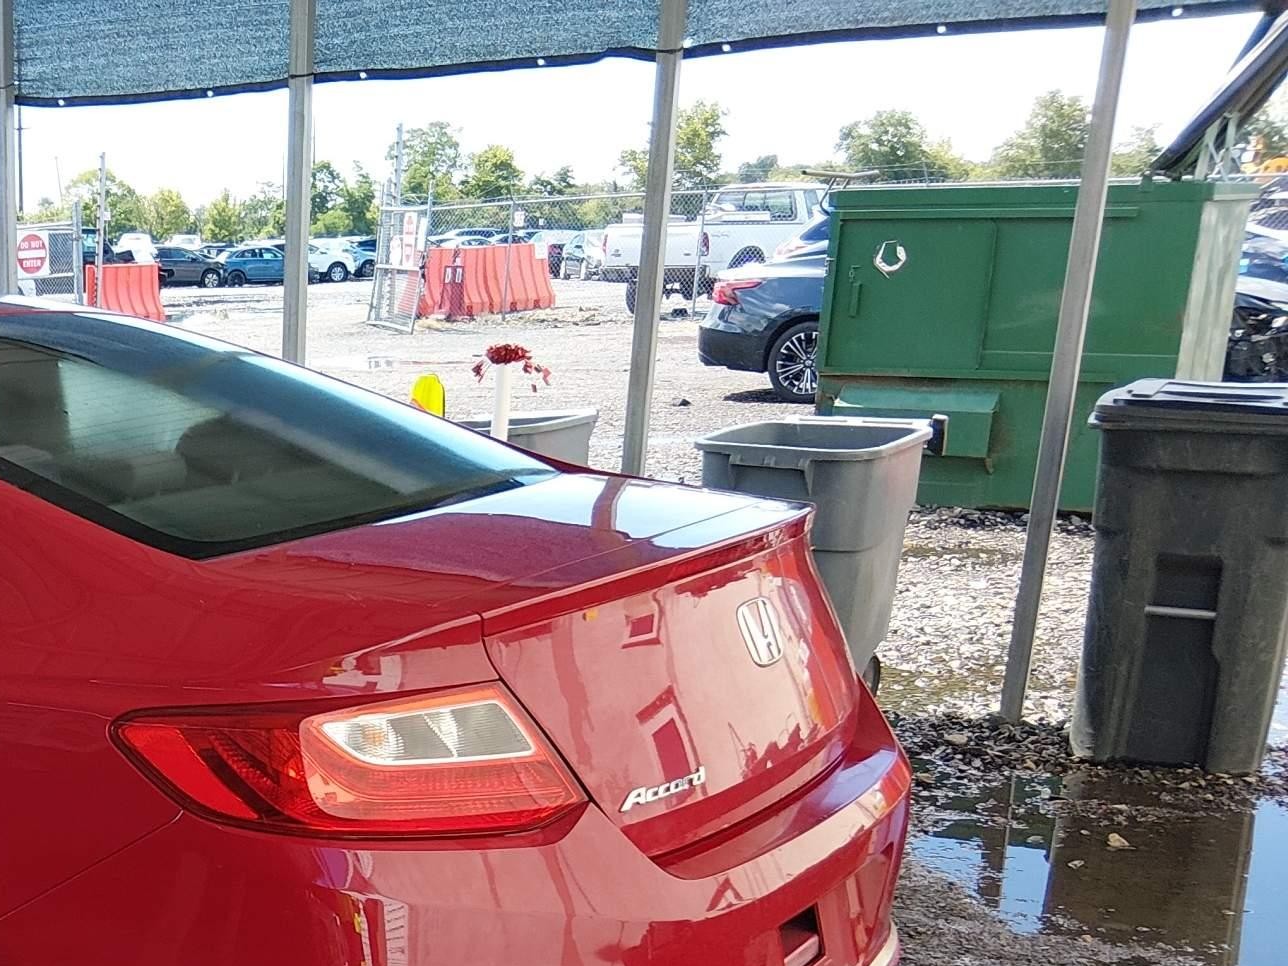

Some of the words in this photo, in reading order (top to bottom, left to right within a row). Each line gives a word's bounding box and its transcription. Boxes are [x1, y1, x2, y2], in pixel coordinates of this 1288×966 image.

[31, 240, 43, 248] NOT
[22, 260, 42, 268] ENTER
[618, 765, 706, 813] Accord
